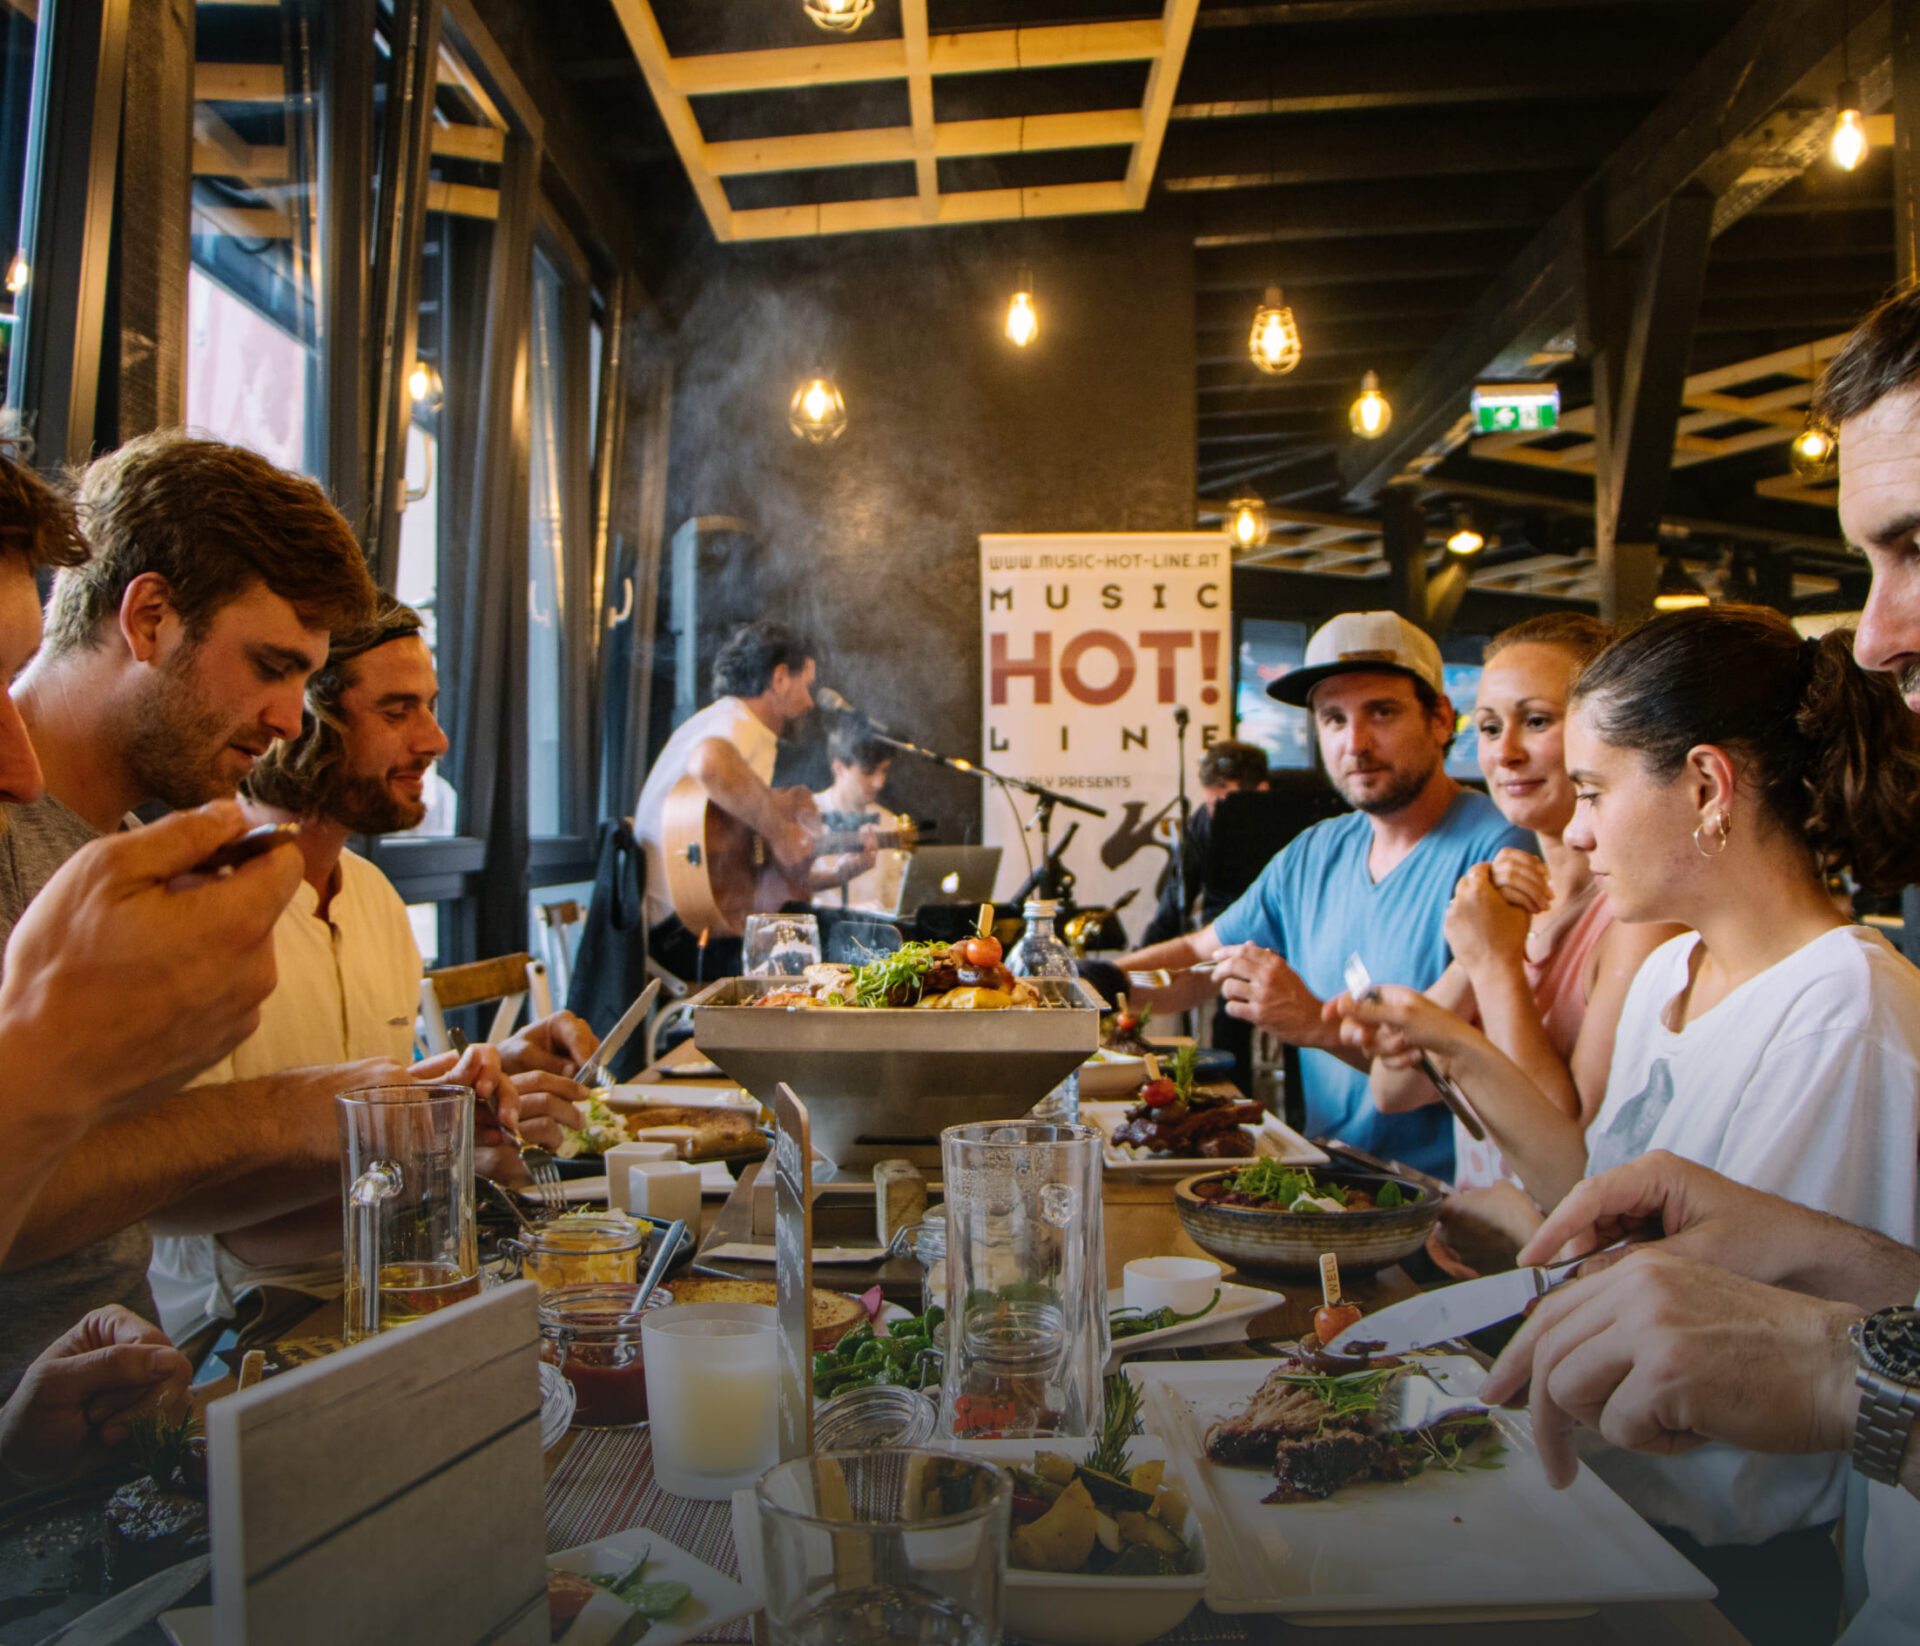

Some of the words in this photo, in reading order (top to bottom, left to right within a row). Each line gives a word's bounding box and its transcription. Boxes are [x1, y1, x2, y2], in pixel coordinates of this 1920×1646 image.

[989, 553, 1220, 570] WWW.MUSIC-HOT-LINE.AT
[990, 583, 1219, 611] MUSIC
[990, 629, 1220, 706] HOT!
[990, 725, 1219, 752] LINE
[1059, 776, 1131, 788] PRESENTS
